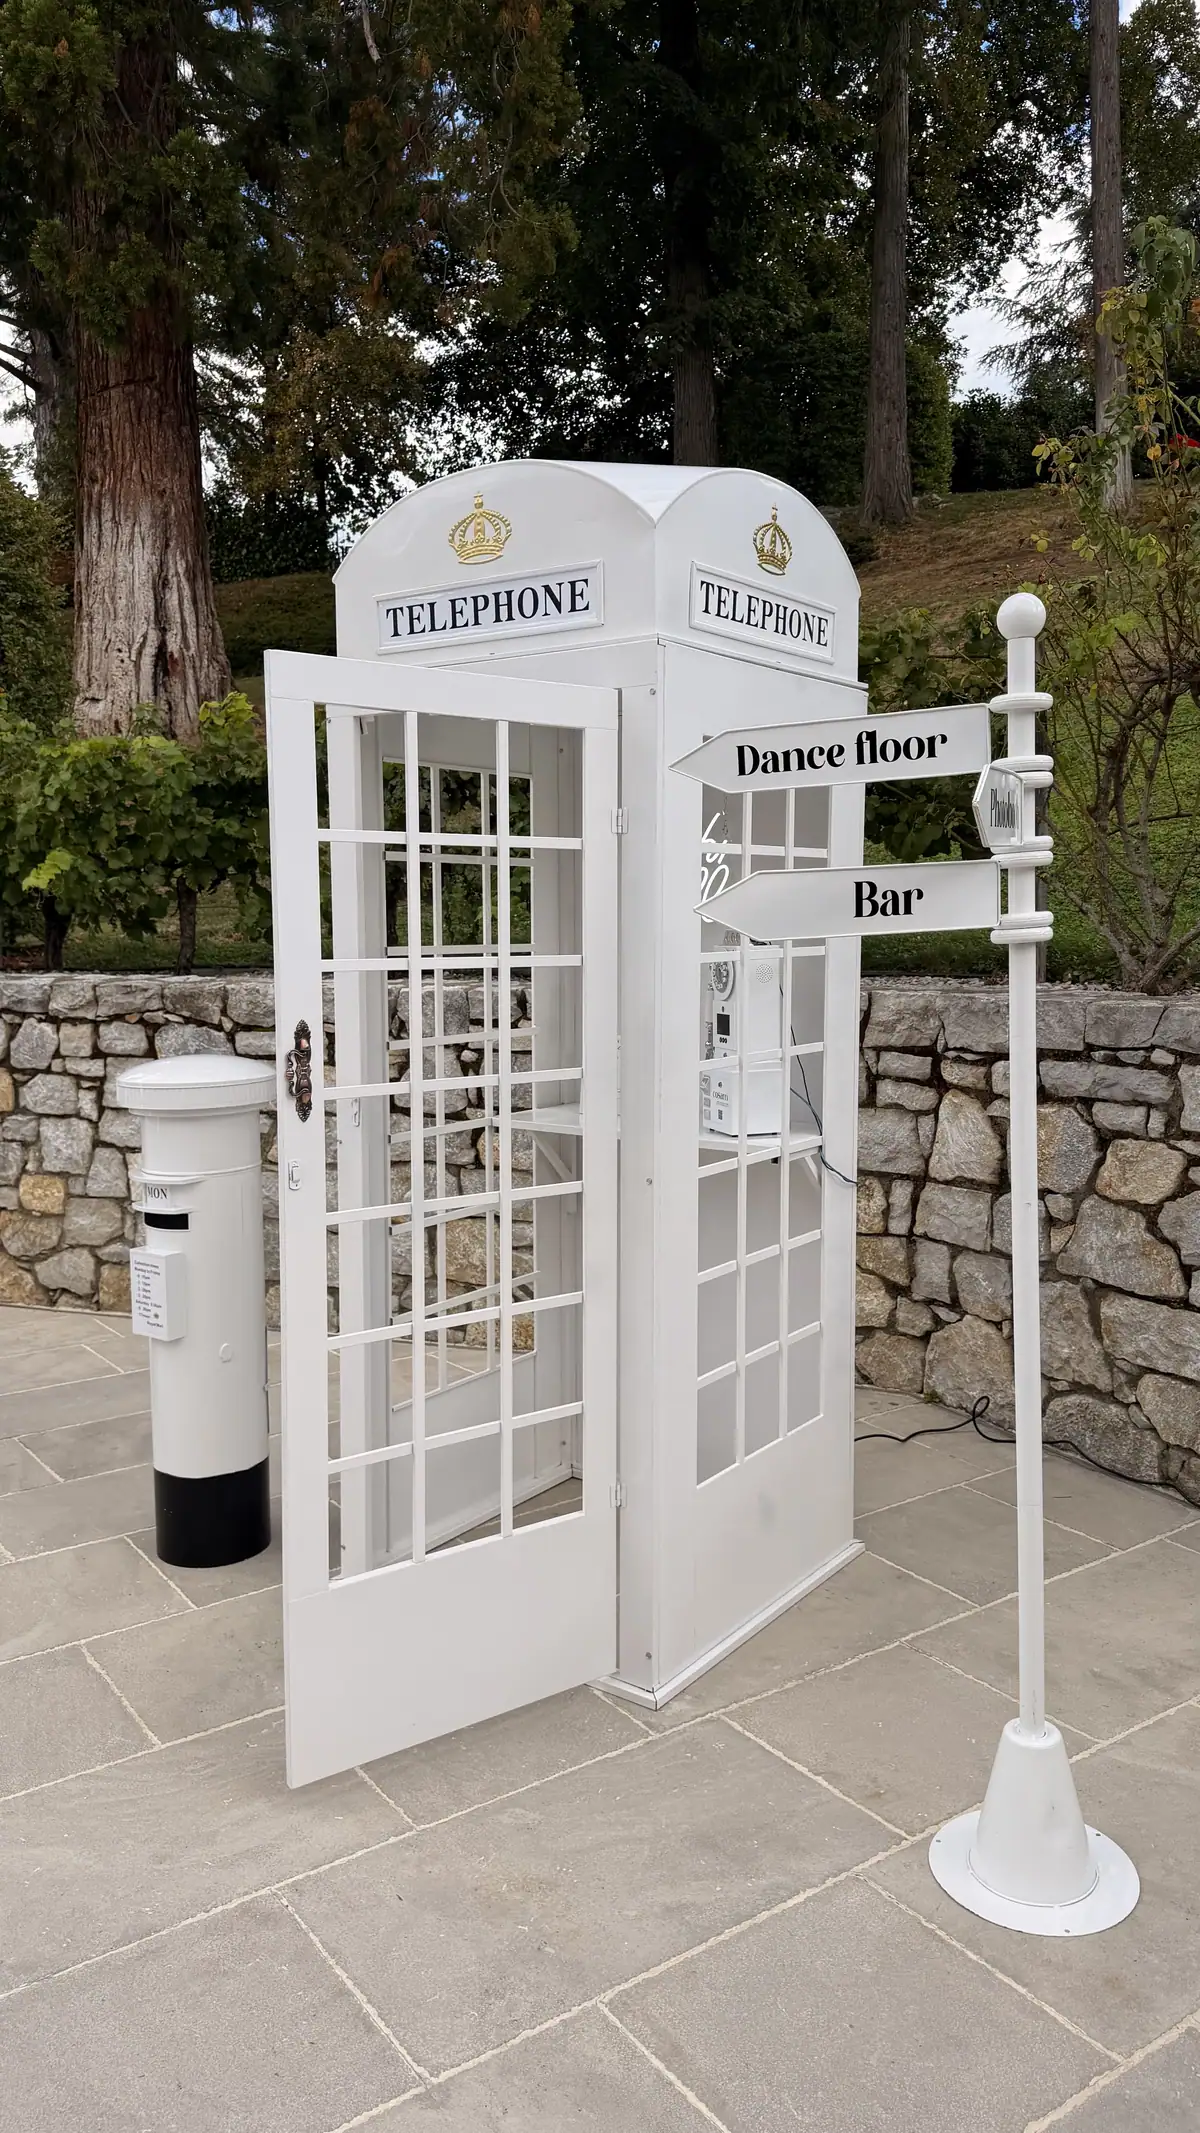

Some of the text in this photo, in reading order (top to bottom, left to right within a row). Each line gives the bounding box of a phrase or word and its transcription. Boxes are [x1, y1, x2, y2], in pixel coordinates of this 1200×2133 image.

[386, 578, 590, 638] TELEPHONE
[700, 580, 829, 647] TELEPHONE
[736, 729, 948, 777] Dance floor
[853, 880, 924, 918] Bar
